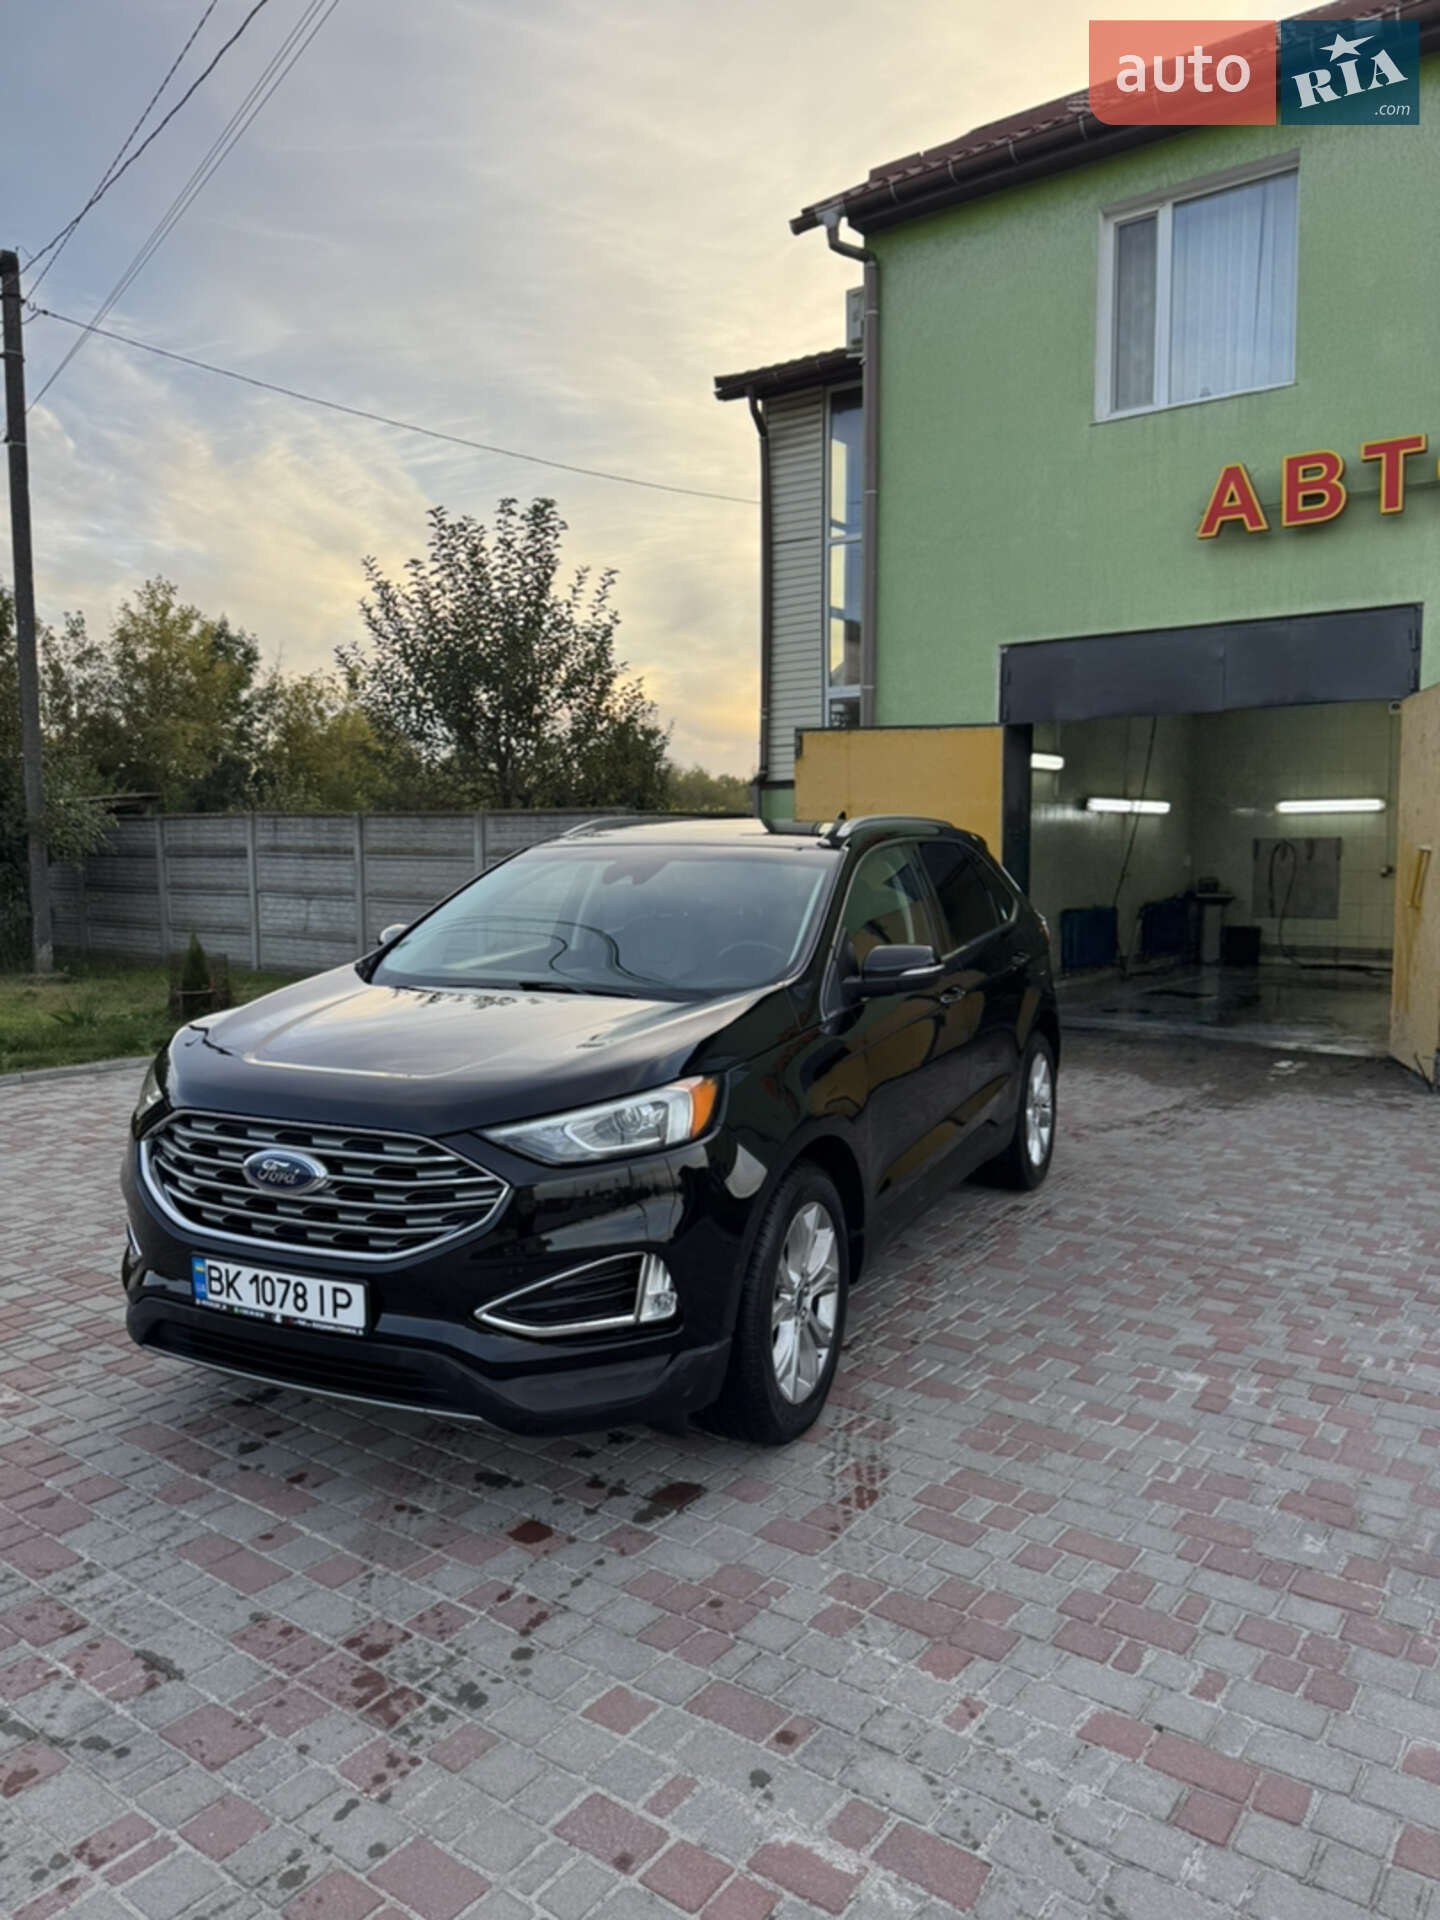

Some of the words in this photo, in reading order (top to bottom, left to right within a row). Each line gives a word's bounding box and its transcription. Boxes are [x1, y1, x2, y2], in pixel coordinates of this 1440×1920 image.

[1197, 433, 1440, 539] АВТ
[257, 1159, 300, 1185] Ford
[207, 1264, 243, 1301] BK
[249, 1273, 308, 1312] 1078
[319, 1285, 352, 1318] IP
